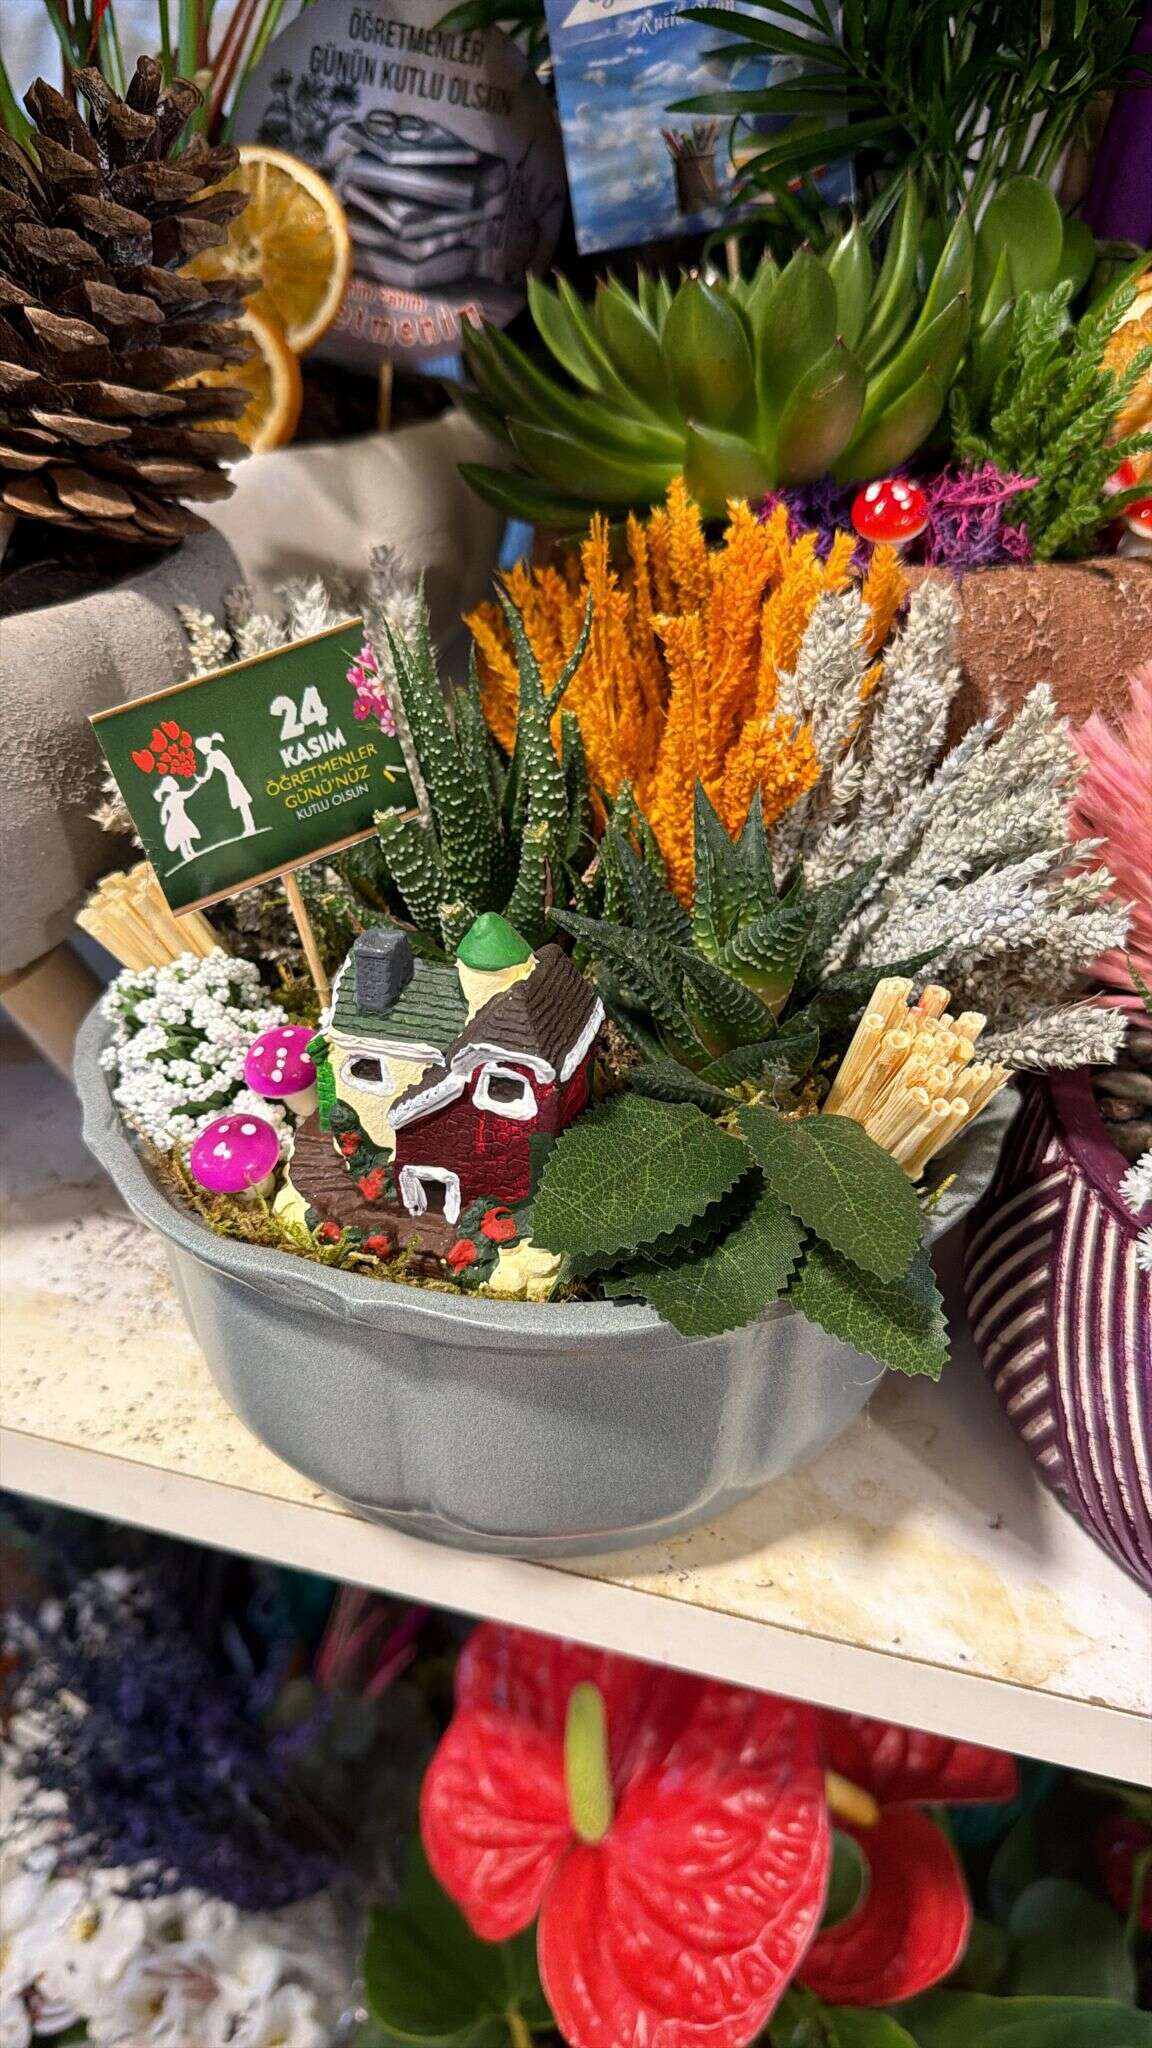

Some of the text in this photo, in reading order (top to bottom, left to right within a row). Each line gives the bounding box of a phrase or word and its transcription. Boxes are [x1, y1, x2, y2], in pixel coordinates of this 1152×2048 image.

[349, 7, 485, 65] ÖĞRETMENLER
[309, 41, 513, 116] GÜNÜN KUTLU OLSUN
[270, 685, 328, 741] 24
[266, 743, 378, 796] ÖĞRETMENLER
[280, 727, 347, 768] KASIM
[285, 765, 371, 808] GÜNÜ'NÜZ
[296, 783, 369, 820] KUTLU OLSUN
